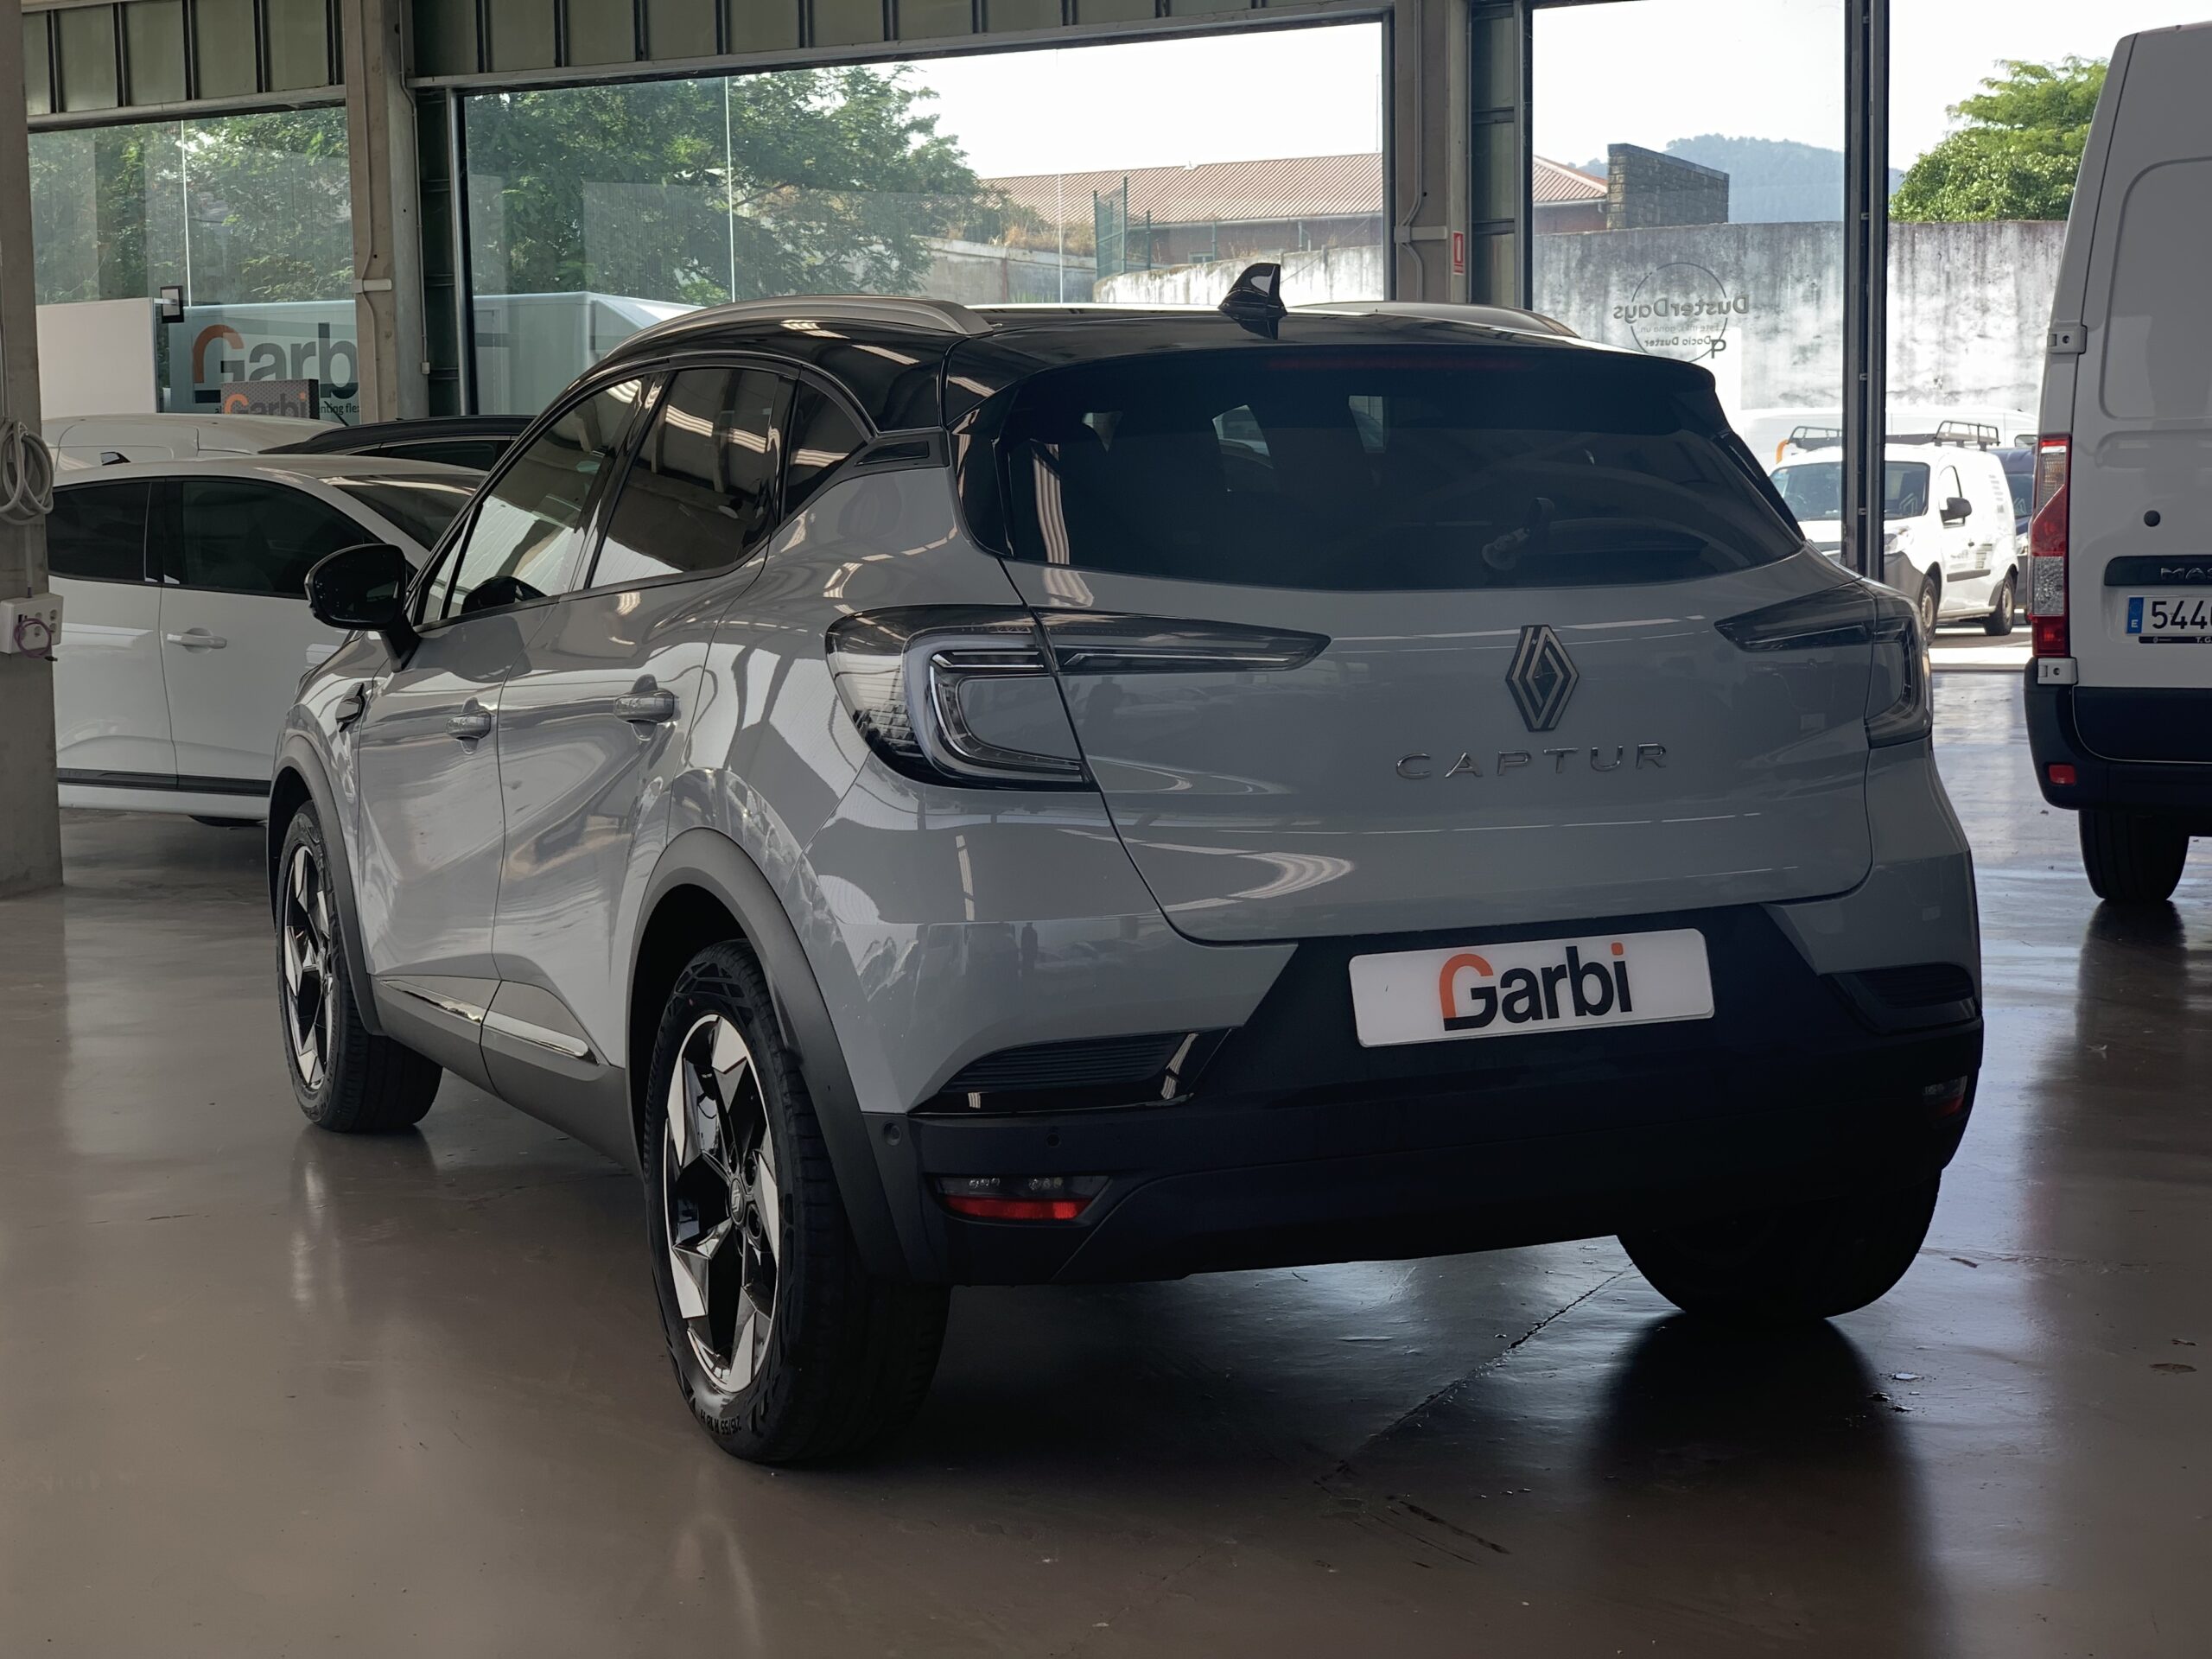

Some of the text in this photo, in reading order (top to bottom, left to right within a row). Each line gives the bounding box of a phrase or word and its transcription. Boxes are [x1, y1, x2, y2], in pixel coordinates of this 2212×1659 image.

[2161, 568, 2212, 582] MA
[2131, 619, 2138, 628] E
[2152, 600, 2212, 629] 544
[1396, 743, 1668, 779] CAPTUR
[1439, 942, 1633, 1032] Garbi
